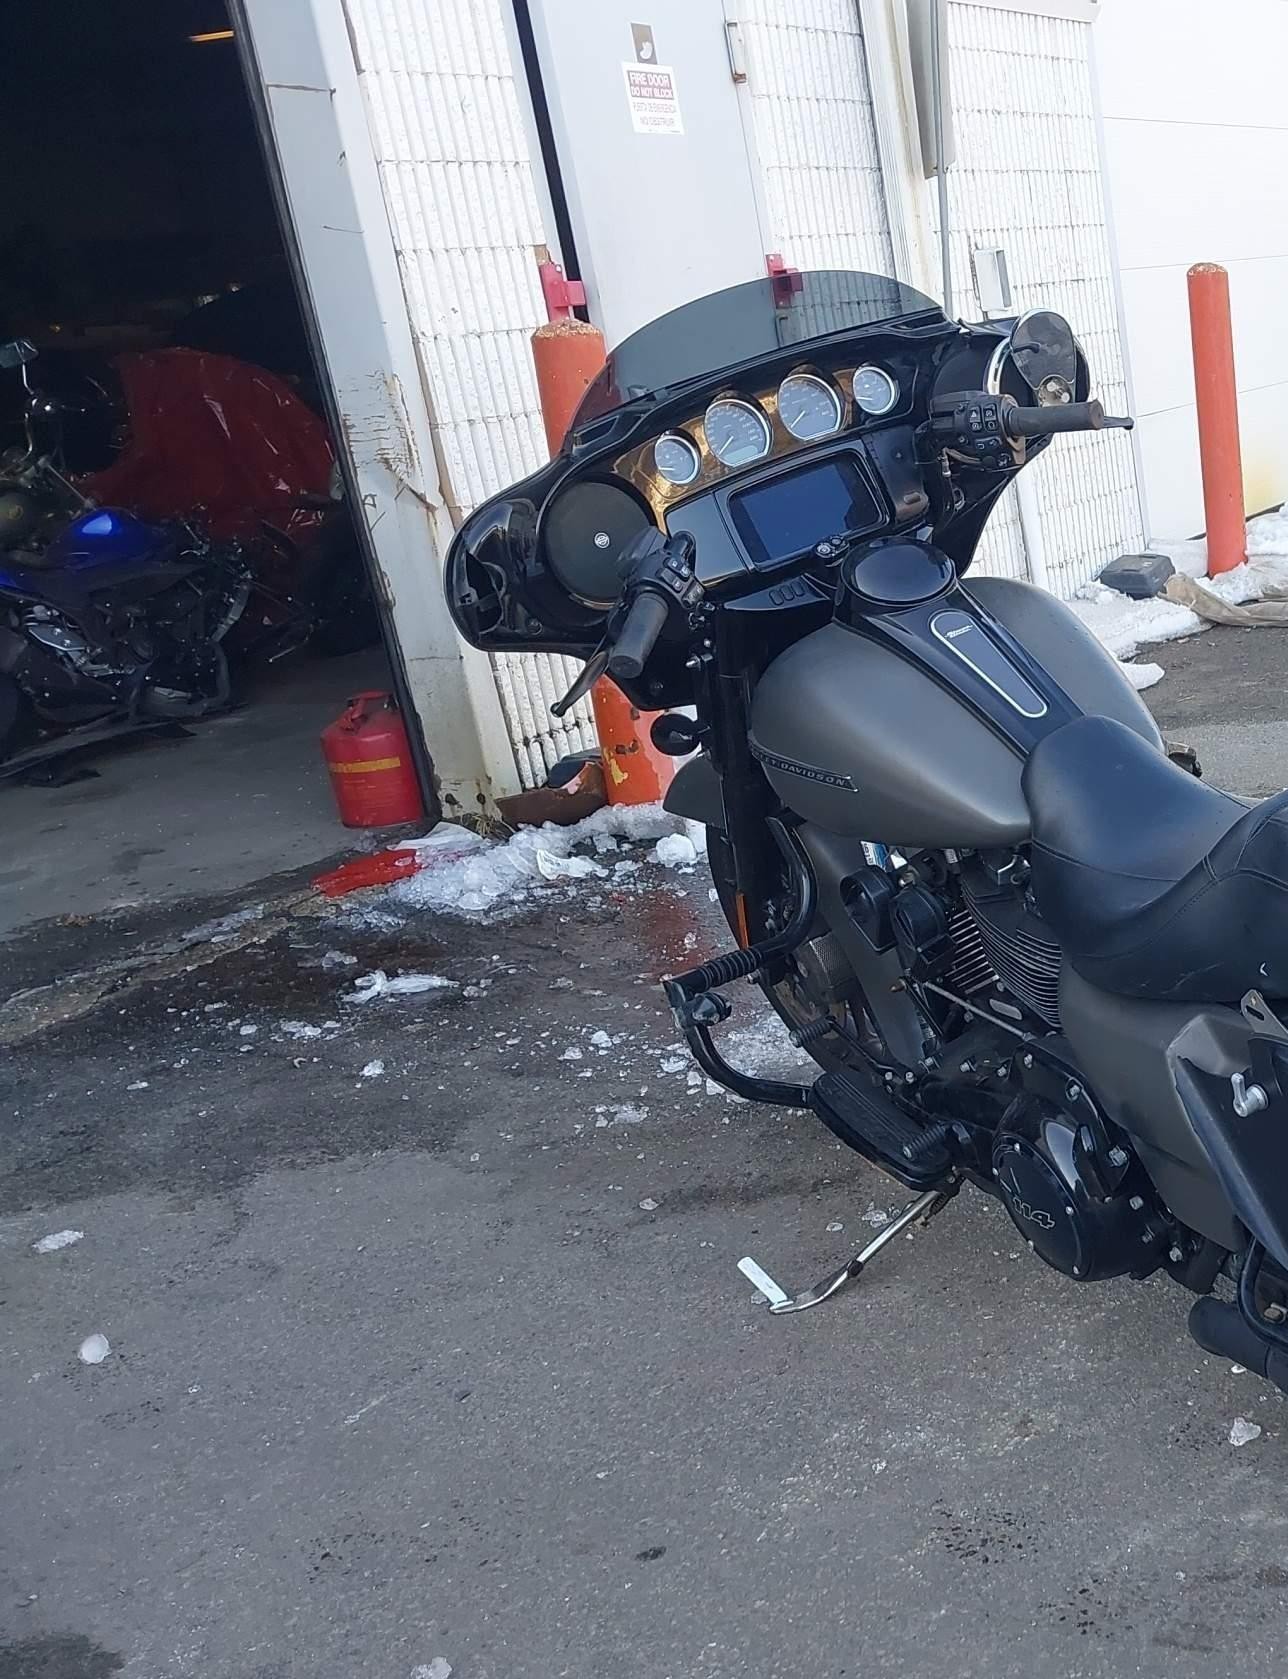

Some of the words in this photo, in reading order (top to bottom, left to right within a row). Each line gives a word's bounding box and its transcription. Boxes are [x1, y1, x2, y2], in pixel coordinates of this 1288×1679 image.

[630, 72, 648, 86] FIRE
[647, 74, 670, 88] DOOR
[631, 86, 641, 97] DO
[641, 87, 653, 97] NOT
[653, 88, 673, 98] BLOCK
[1013, 1196, 1056, 1230] 114
